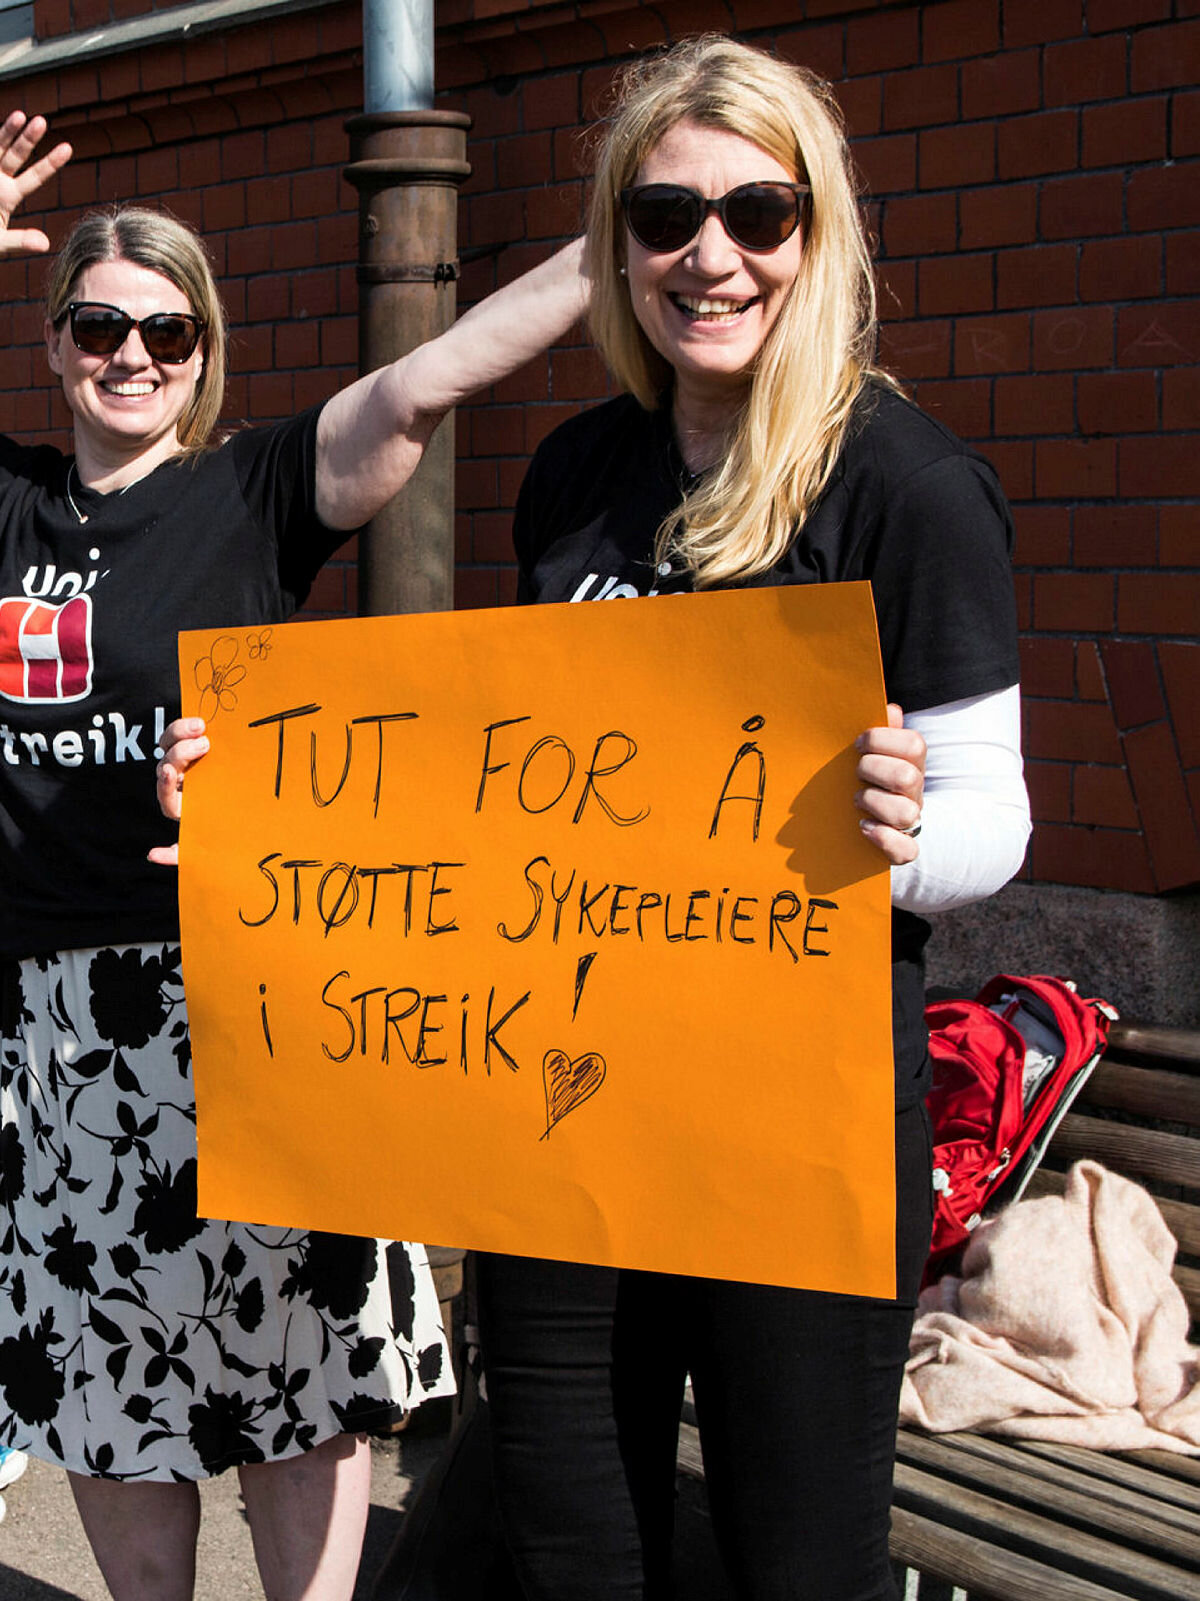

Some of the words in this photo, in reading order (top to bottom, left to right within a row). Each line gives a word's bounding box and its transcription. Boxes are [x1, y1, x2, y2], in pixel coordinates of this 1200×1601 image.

[248, 703, 419, 818] TUT
[476, 716, 651, 827] FOR
[709, 715, 766, 842] Å
[239, 853, 466, 938] STØTTE
